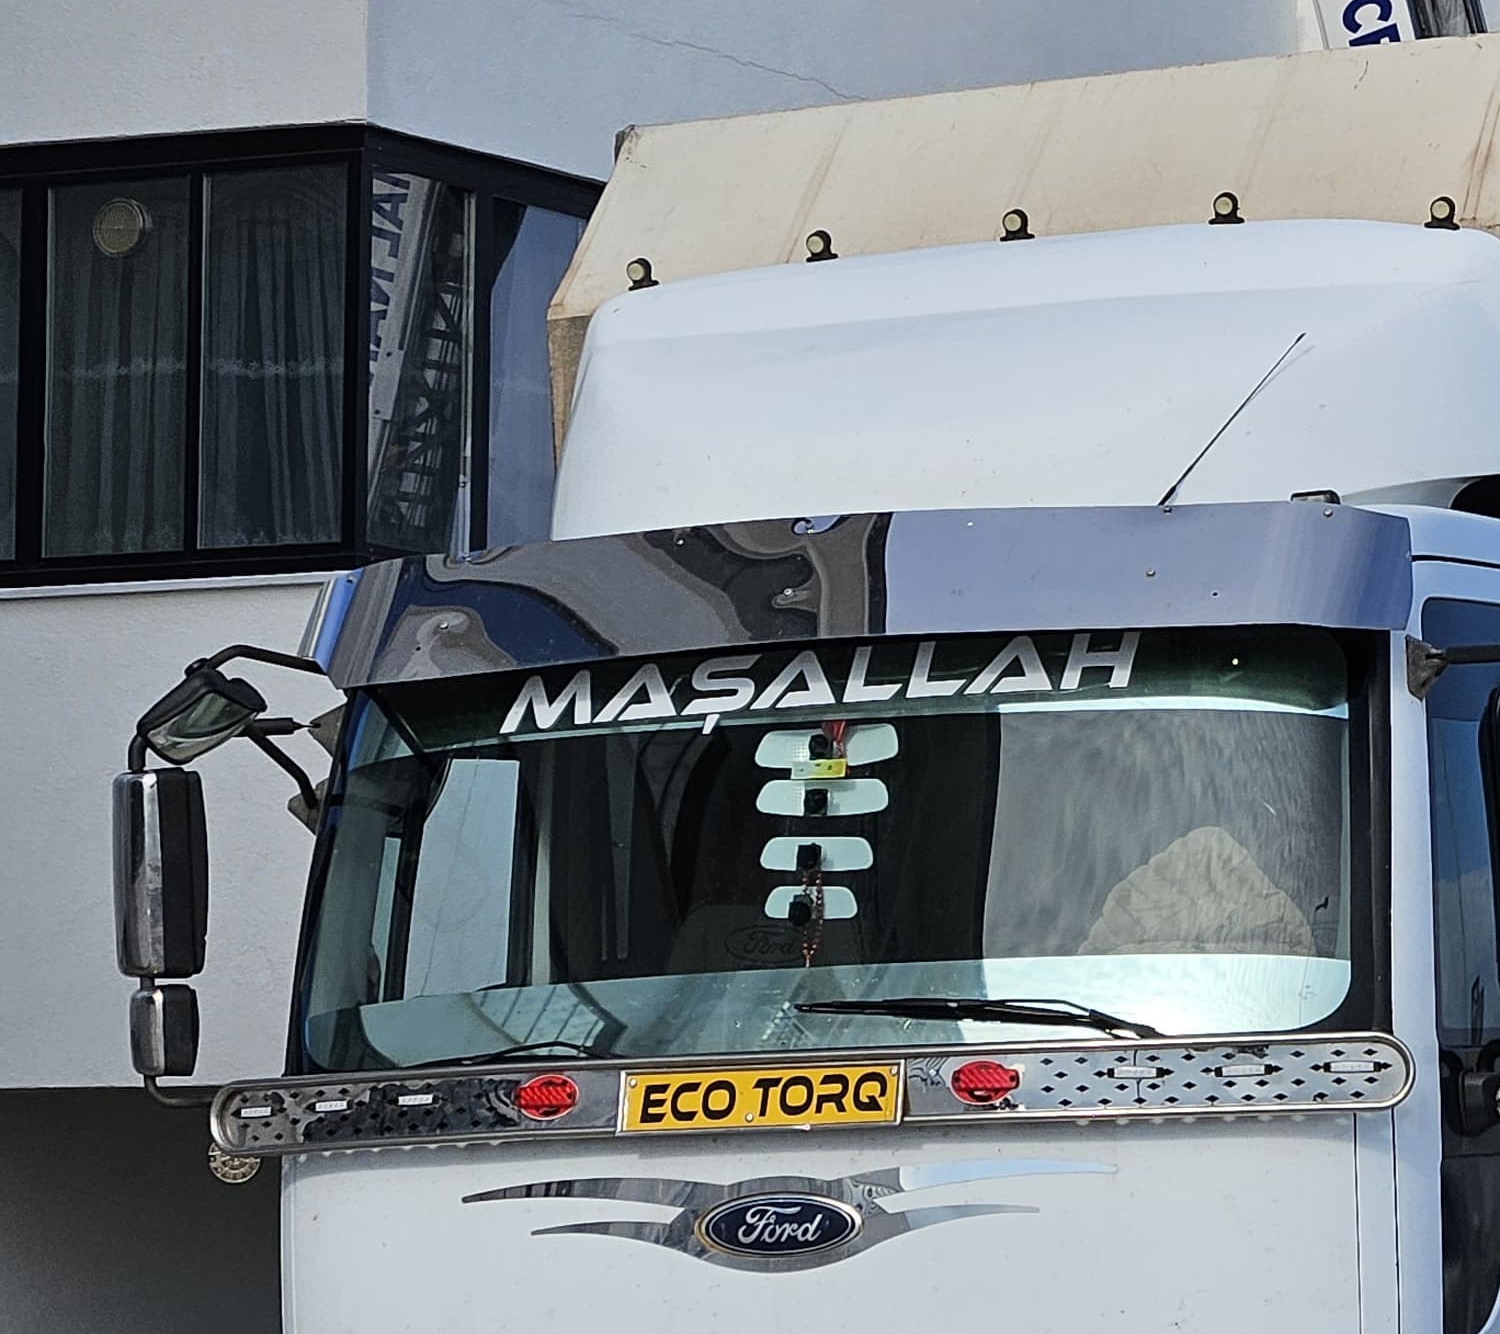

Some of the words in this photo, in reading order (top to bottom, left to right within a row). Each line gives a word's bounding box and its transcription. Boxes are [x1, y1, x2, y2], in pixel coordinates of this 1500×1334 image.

[499, 630, 1143, 735] MAŞALLAH
[639, 1079, 737, 1124] ECO
[752, 1071, 889, 1118] TORQ
[737, 1205, 823, 1244] Ford
